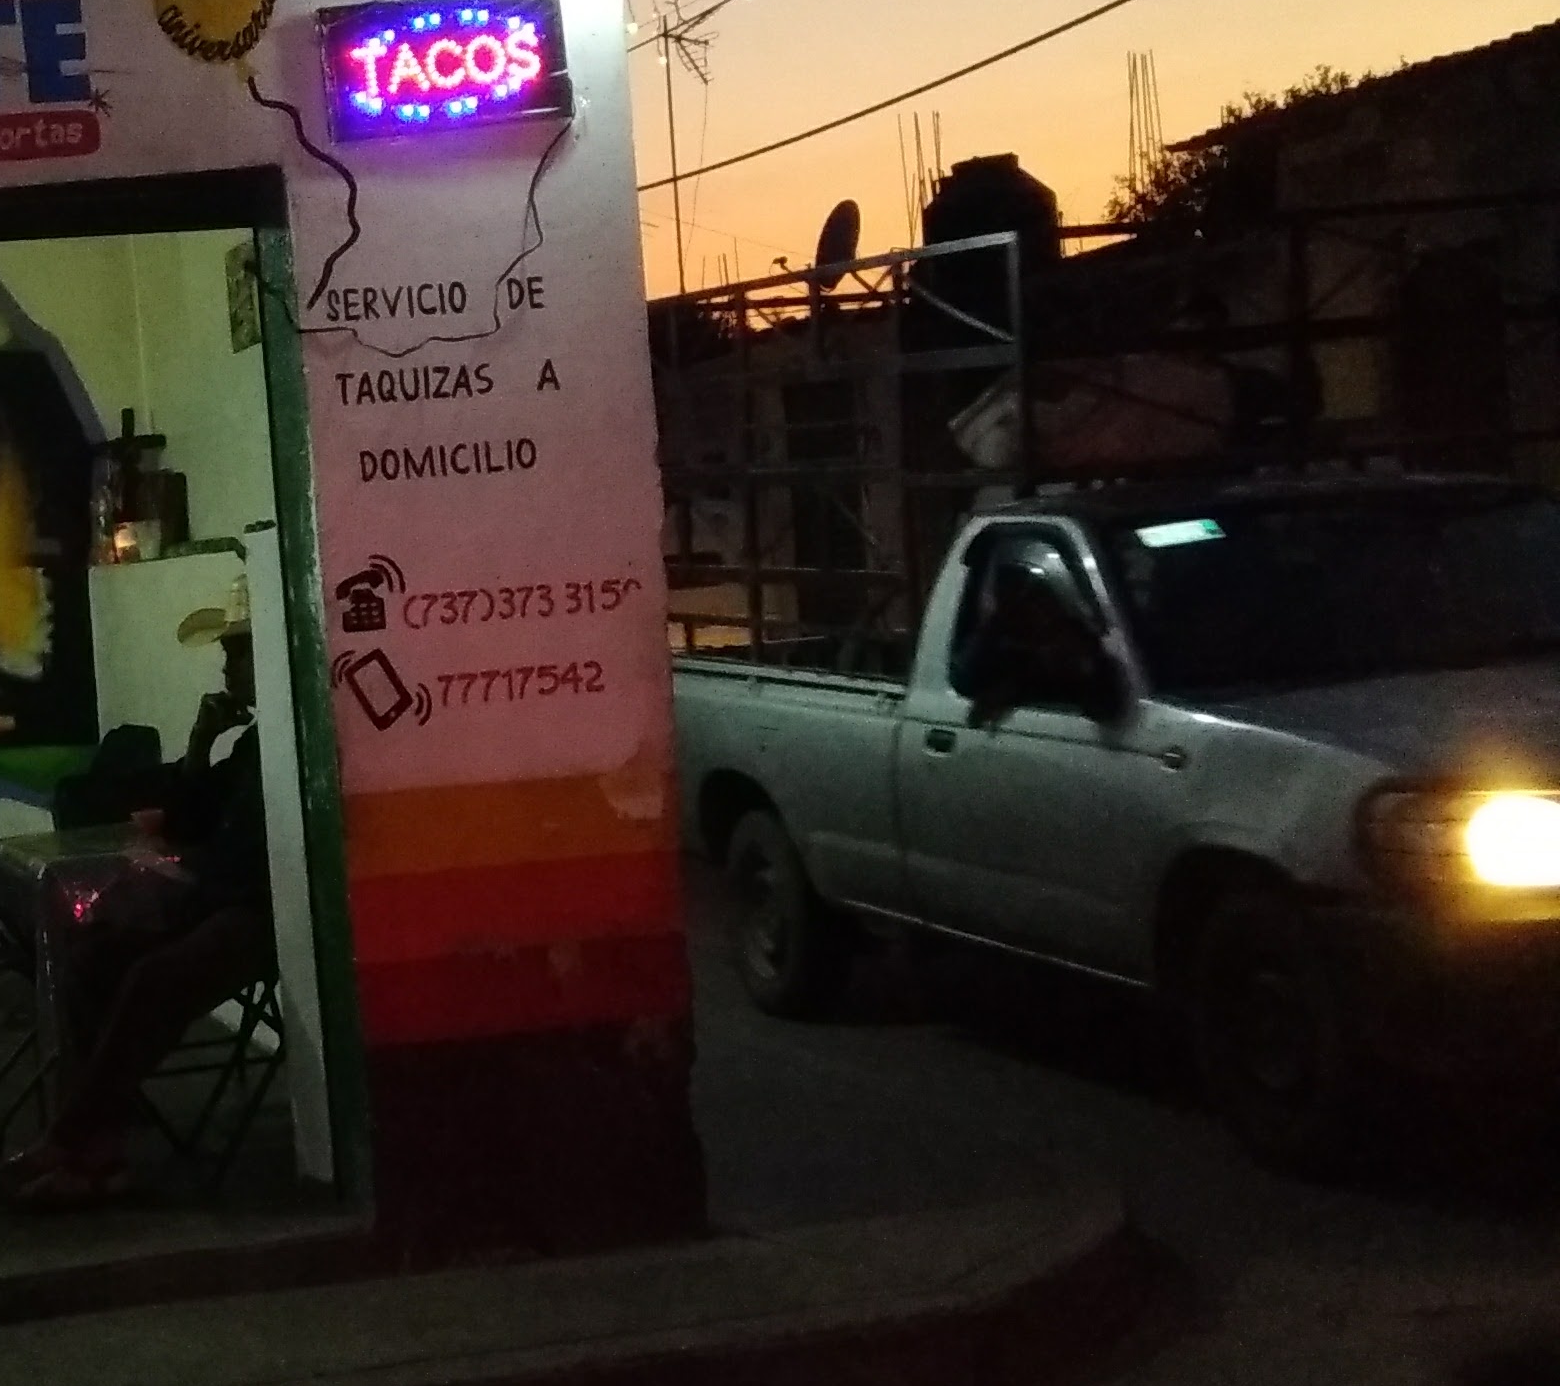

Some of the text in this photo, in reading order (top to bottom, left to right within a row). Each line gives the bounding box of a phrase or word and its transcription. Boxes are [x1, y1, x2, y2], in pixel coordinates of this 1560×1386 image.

[350, 25, 542, 96] TACOS
[326, 275, 546, 321] SERVICIO DE
[335, 358, 561, 405] TAQUIZAS A
[359, 437, 538, 482] DOMICILIO
[437, 660, 606, 707] 77717542
